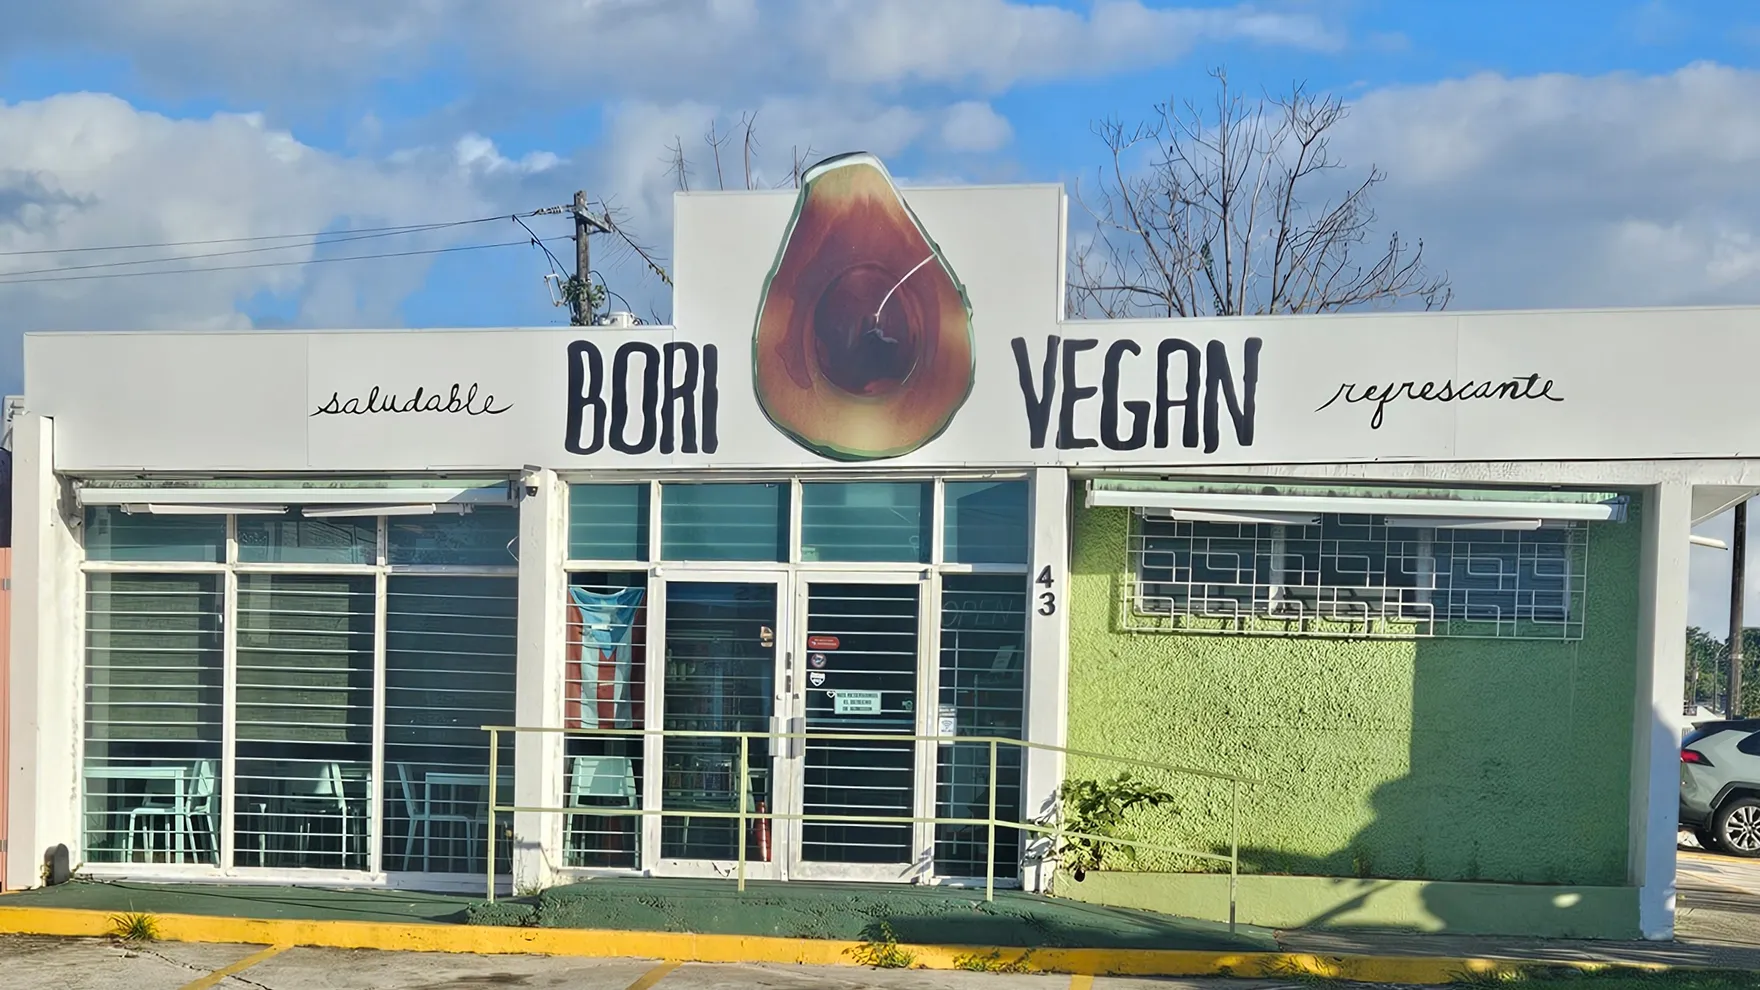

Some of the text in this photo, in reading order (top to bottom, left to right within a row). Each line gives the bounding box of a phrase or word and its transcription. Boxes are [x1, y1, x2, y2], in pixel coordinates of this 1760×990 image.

[309, 382, 514, 417] saludable
[565, 334, 1263, 455] BORI VEGAN
[1314, 372, 1565, 430] refrescante
[942, 599, 1013, 627] OPEN
